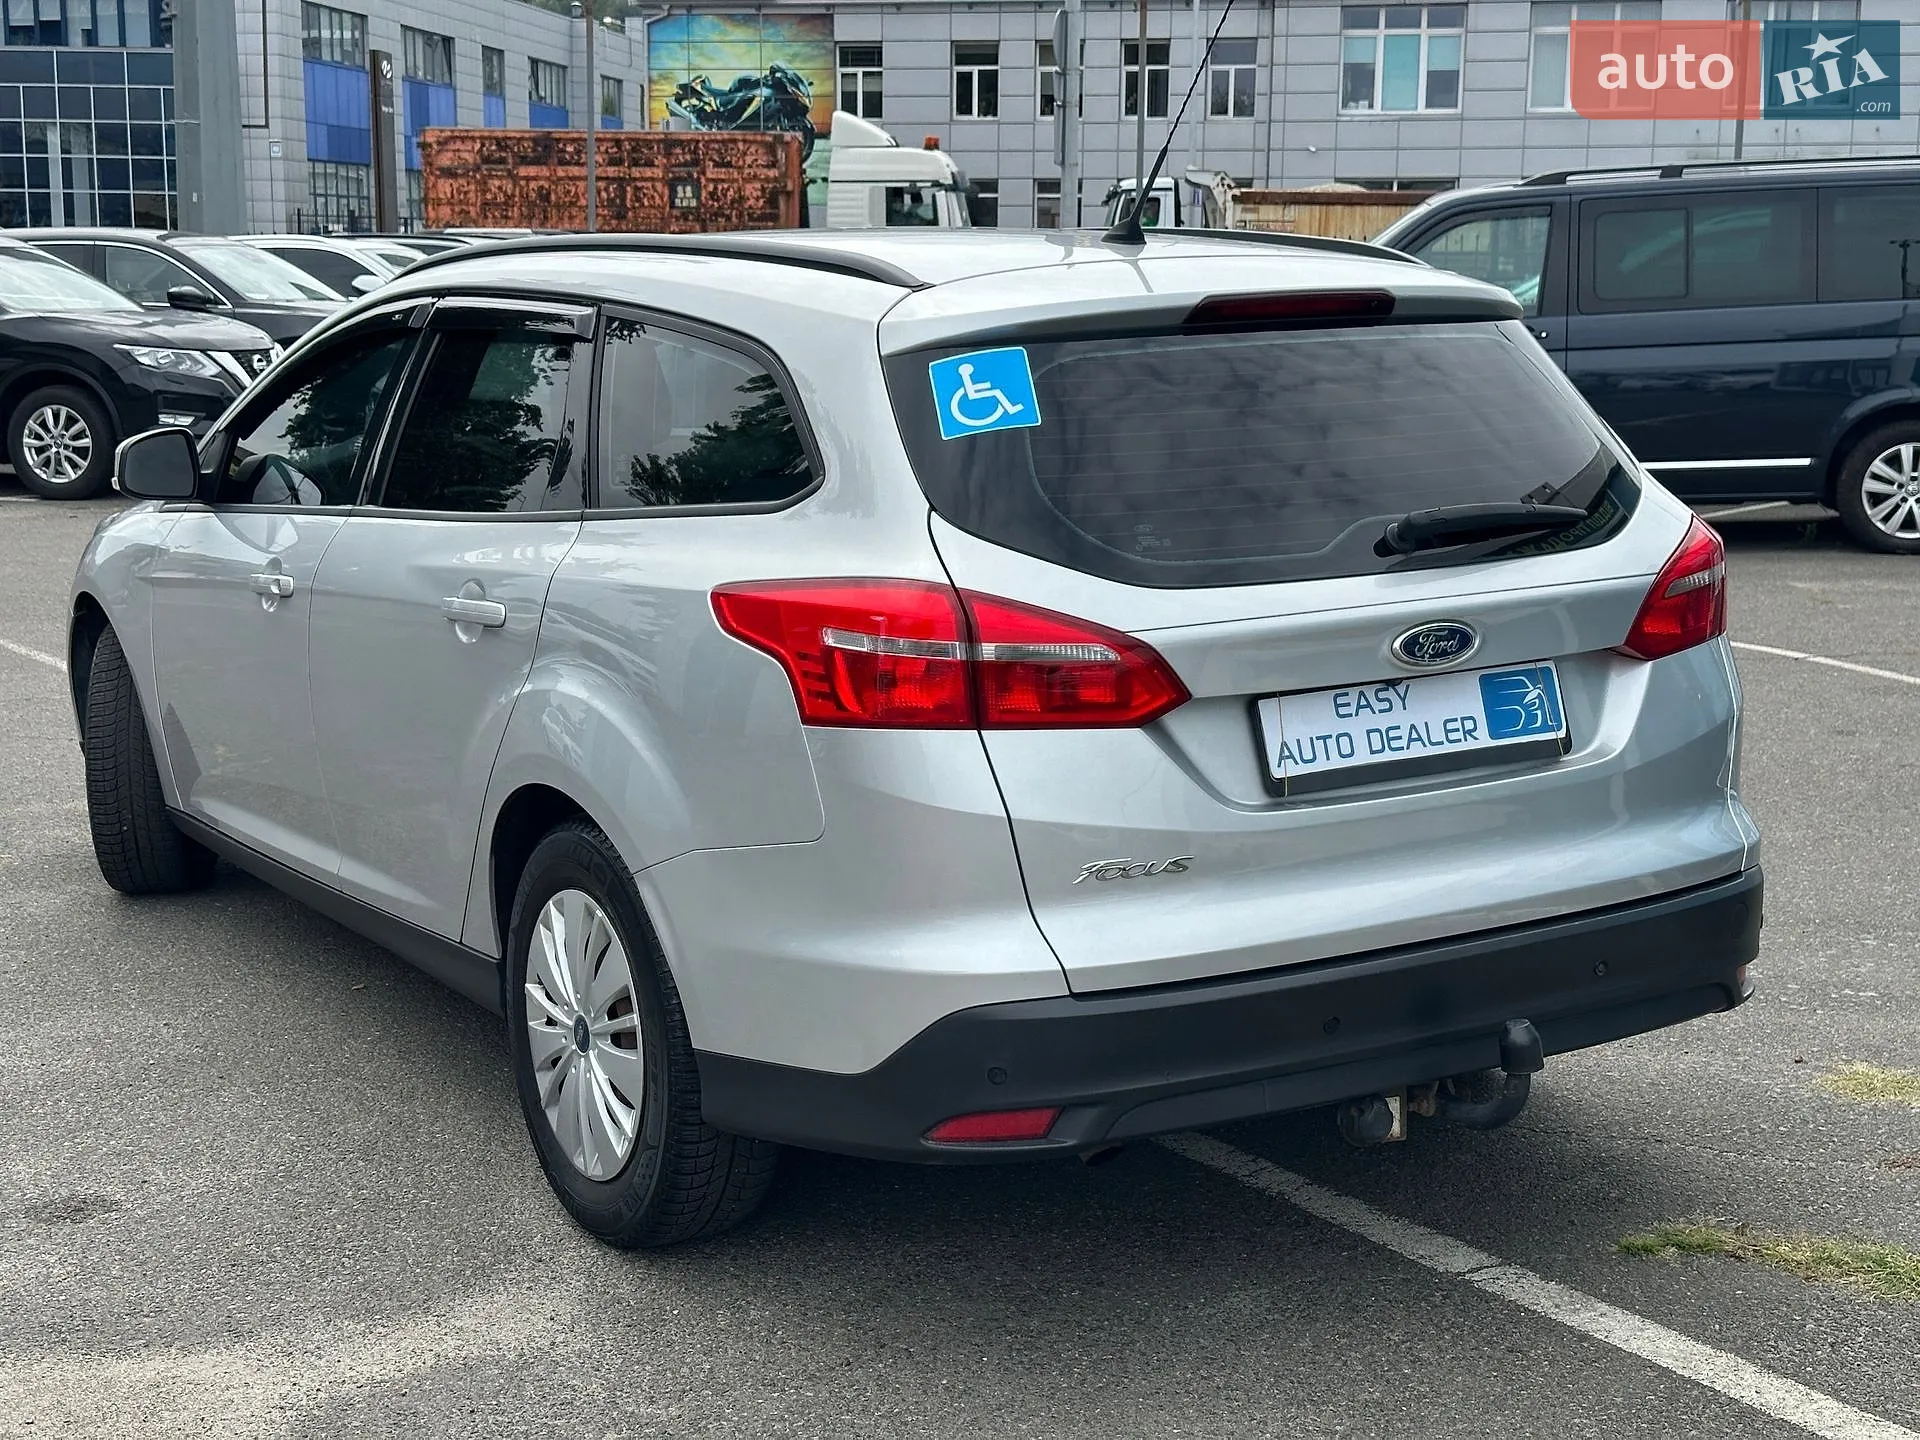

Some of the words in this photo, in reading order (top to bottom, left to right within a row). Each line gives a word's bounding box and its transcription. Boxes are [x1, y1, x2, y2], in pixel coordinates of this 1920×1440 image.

[1414, 630, 1461, 657] Ford
[1332, 684, 1411, 719] EASY
[1277, 732, 1355, 768] AUTO
[1366, 715, 1480, 755] DEALER
